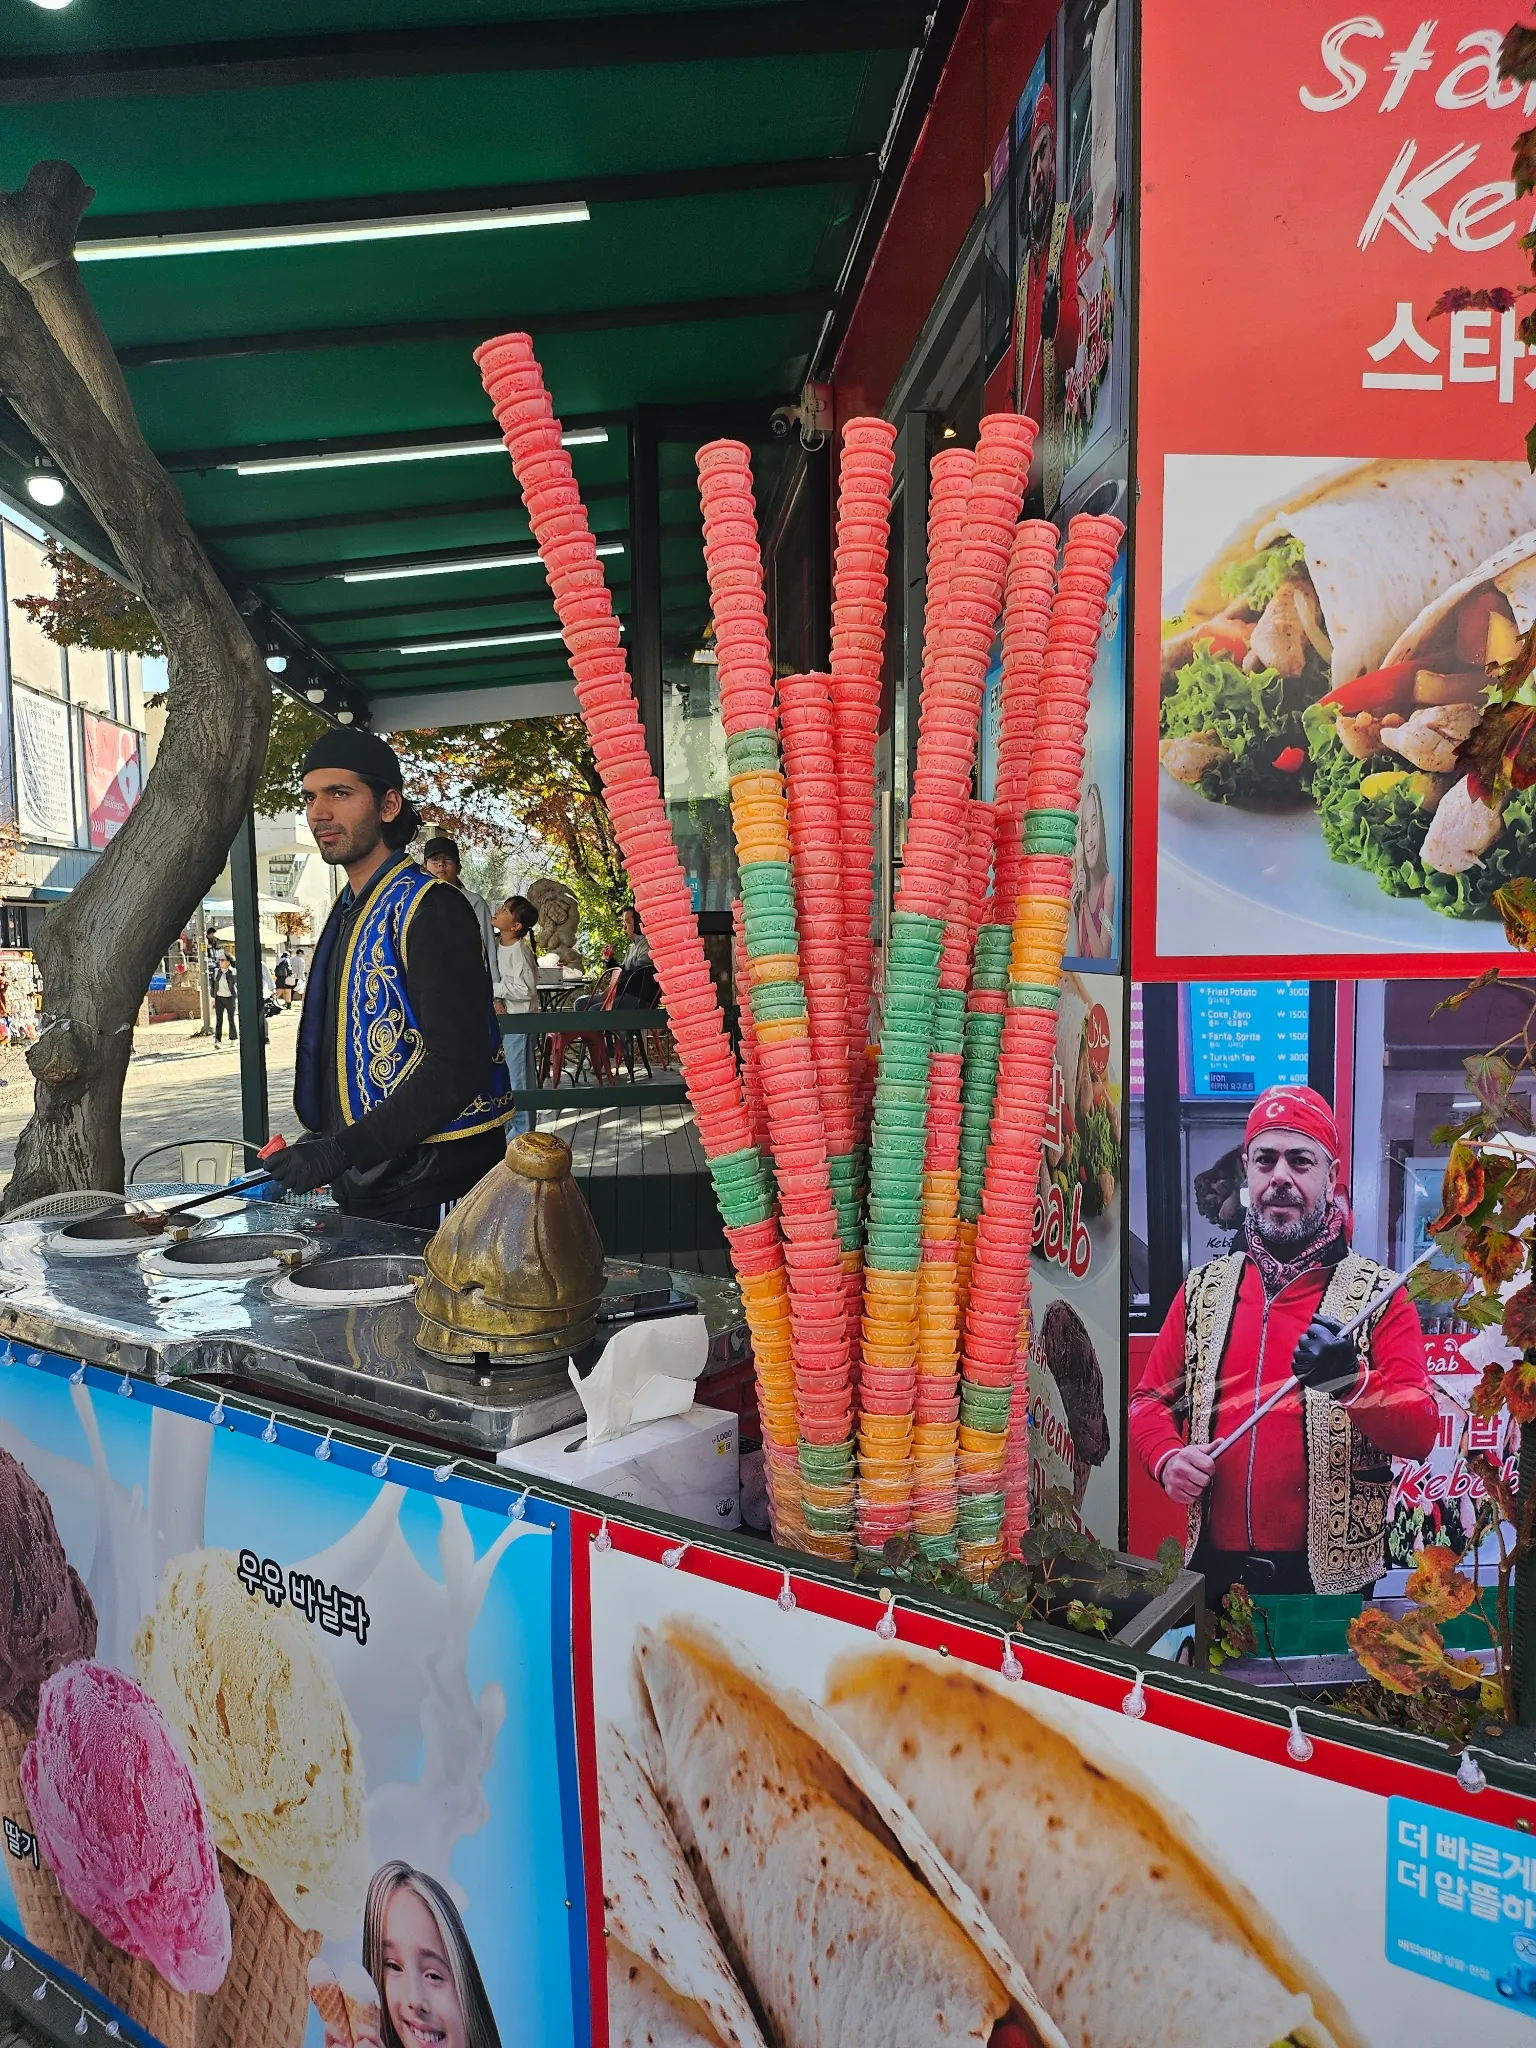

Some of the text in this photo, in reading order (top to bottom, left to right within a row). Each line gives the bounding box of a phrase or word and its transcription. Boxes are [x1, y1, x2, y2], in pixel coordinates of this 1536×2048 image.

[1299, 16, 1536, 117] Sta
[1356, 139, 1536, 253] Ke
[1362, 303, 1536, 403] 스타
[1207, 988, 1228, 996] Fried
[1230, 988, 1257, 996] Potato
[1233, 1010, 1251, 1018] Zero
[1210, 1053, 1239, 1061] Turkish
[1236, 1032, 1260, 1042] Sprite
[237, 1548, 371, 1645] 우유 바닐라
[2, 1815, 41, 1870] 딸기
[1398, 1819, 1536, 1893] 더 빠르게
[1397, 1858, 1428, 1899] 더
